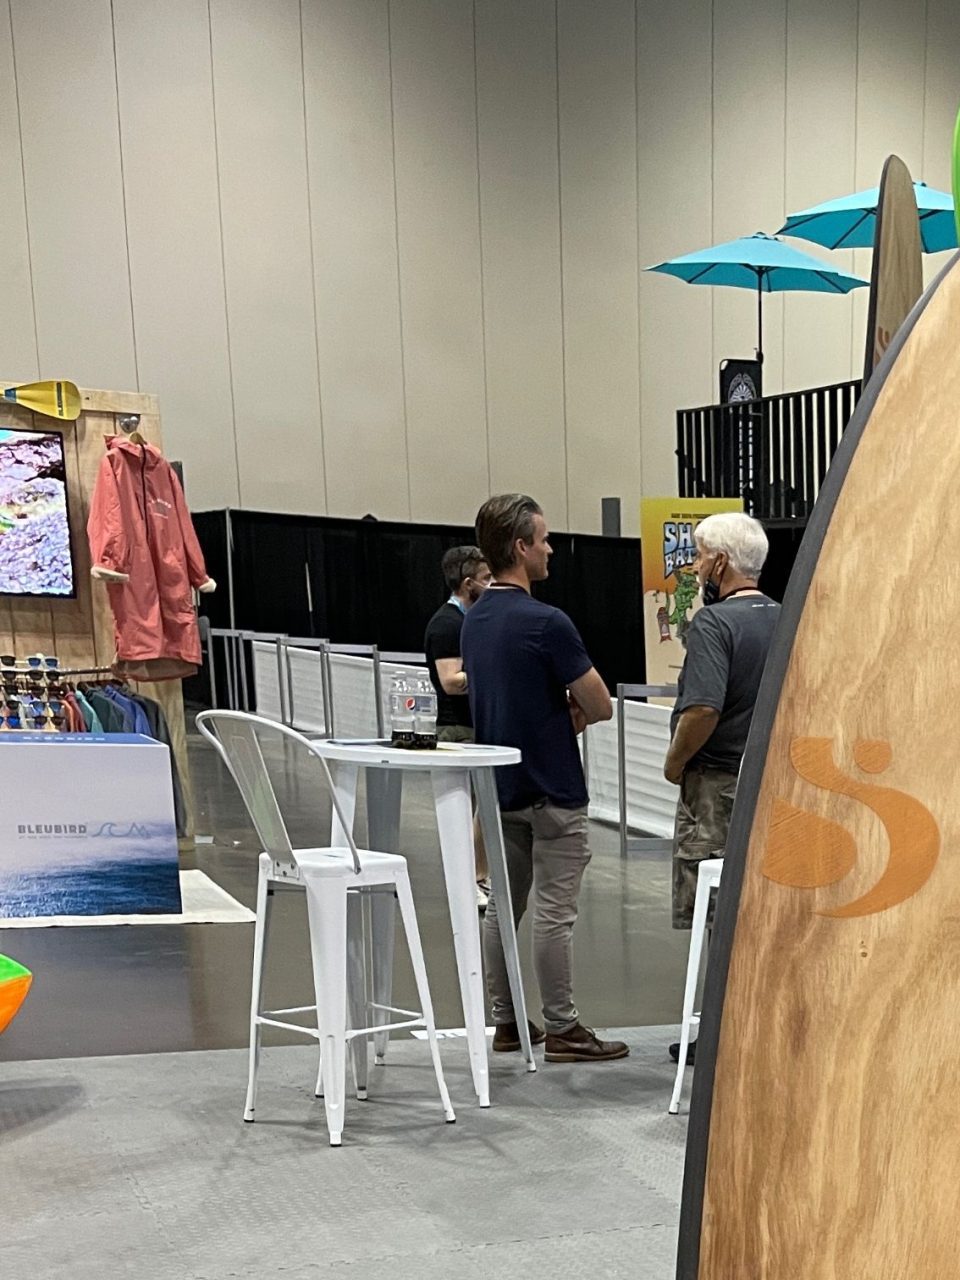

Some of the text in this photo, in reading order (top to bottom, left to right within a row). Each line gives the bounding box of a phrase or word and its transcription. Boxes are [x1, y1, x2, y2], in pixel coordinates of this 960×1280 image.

[663, 522, 700, 556] SH
[664, 548, 698, 579] BAT
[17, 824, 88, 834] BLEUBIRD
